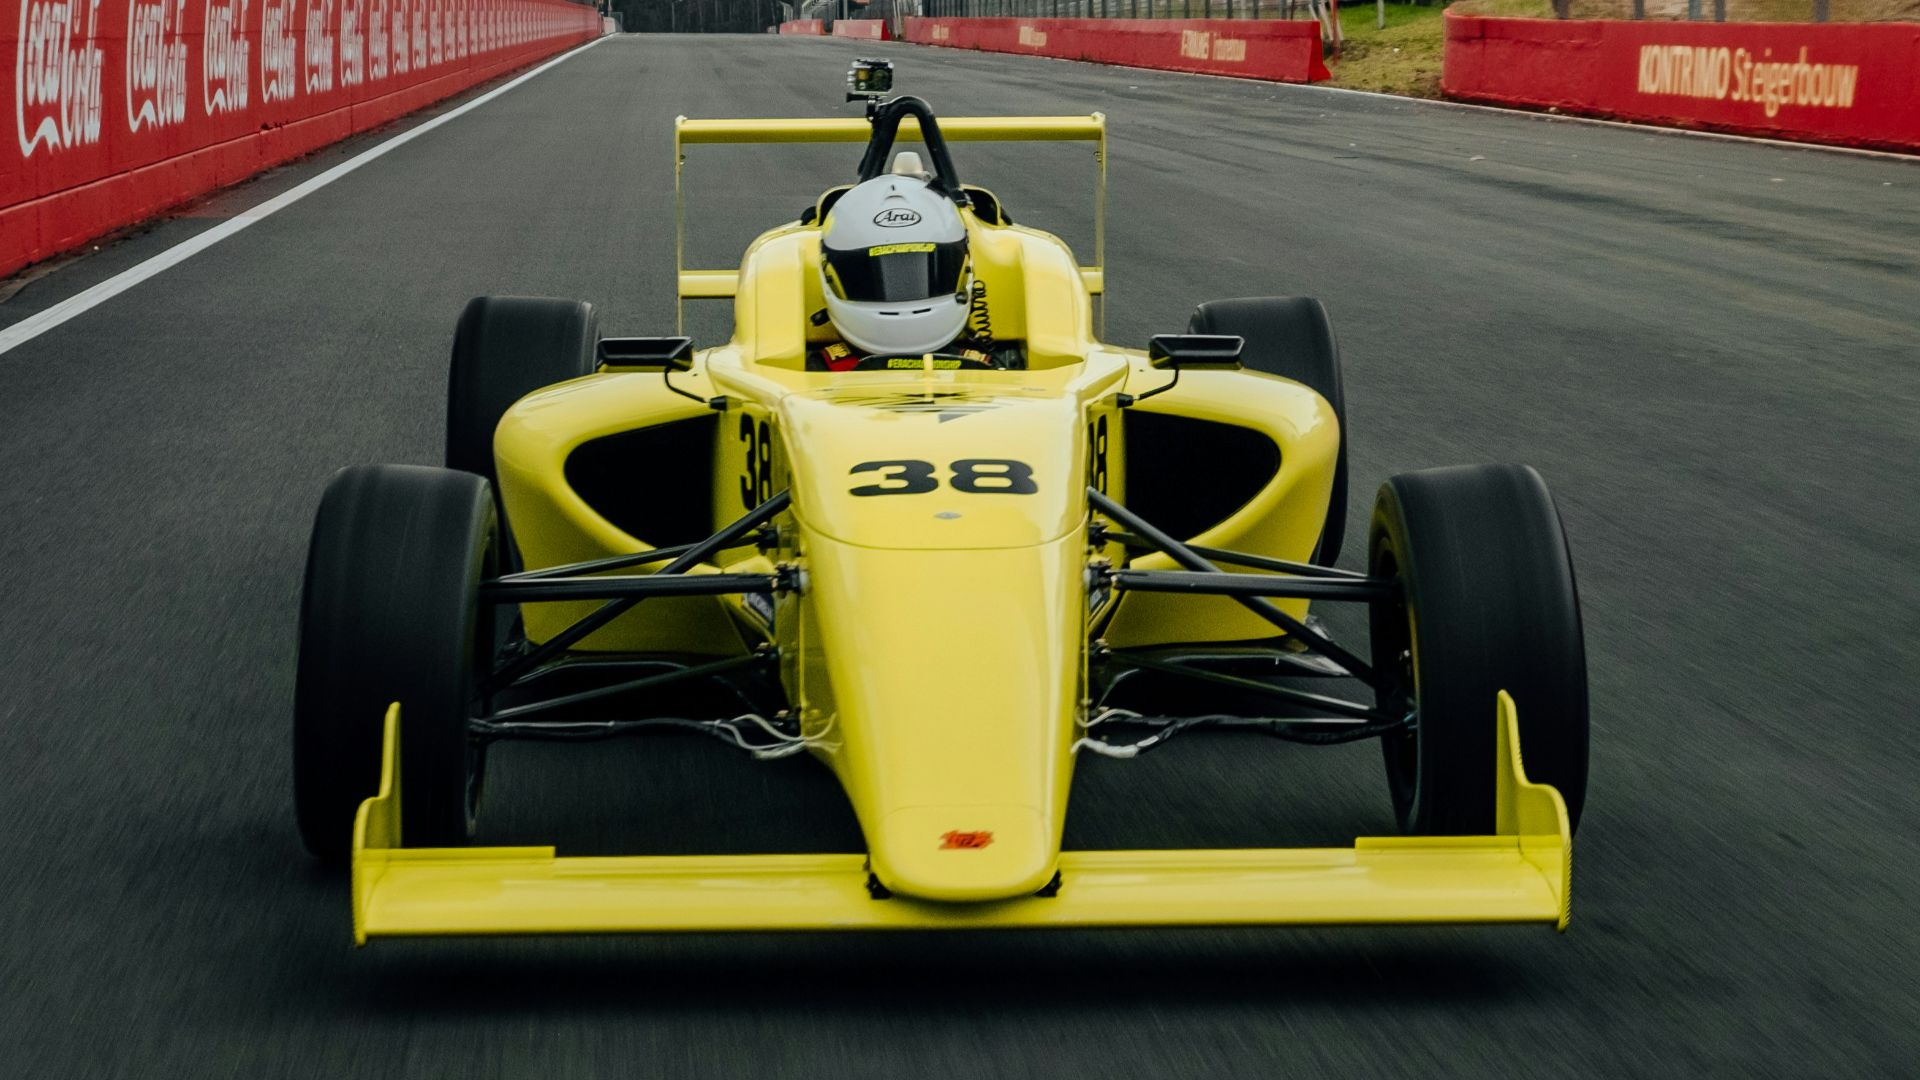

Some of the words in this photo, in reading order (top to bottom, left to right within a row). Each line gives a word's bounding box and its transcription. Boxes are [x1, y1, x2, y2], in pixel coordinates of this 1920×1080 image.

[1638, 44, 1730, 100] KONTRIMO
[1731, 45, 1859, 118] Steigerbouw
[877, 210, 916, 224] Arai
[740, 411, 773, 511] 38
[849, 459, 1039, 497] 38
